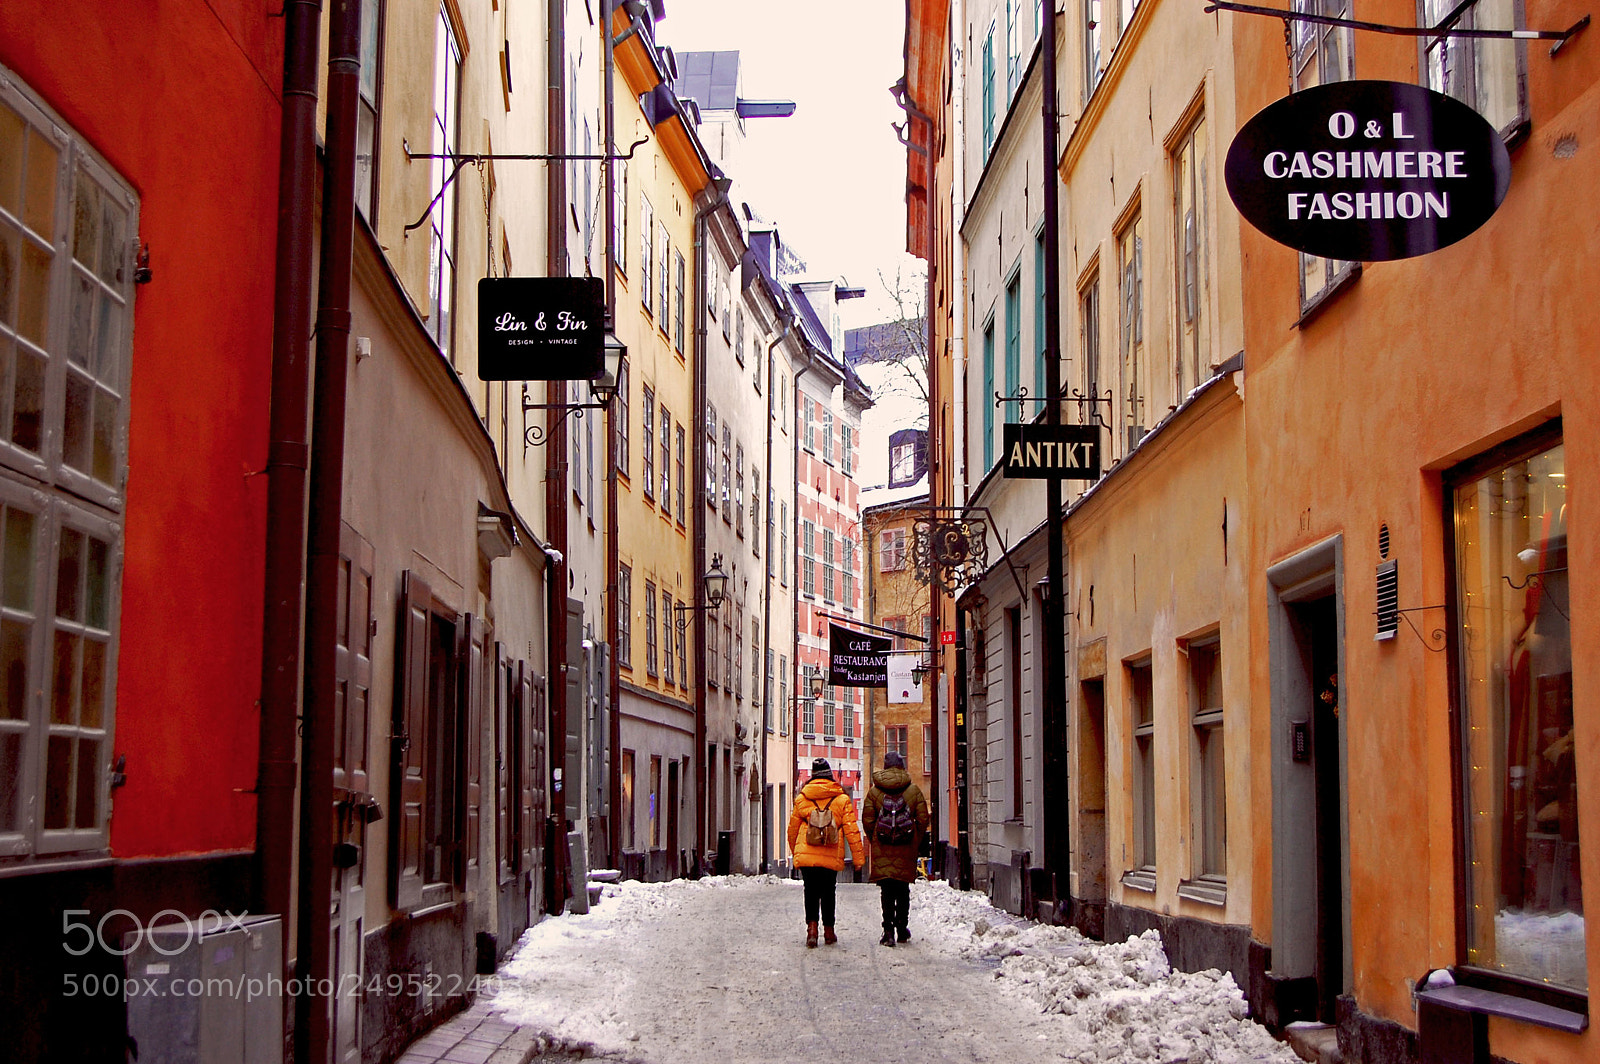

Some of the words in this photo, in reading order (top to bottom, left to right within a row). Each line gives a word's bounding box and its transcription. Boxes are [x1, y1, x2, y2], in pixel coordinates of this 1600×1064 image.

[1328, 112, 1355, 139] O
[1363, 120, 1381, 139] &
[1392, 112, 1414, 139] L
[1263, 151, 1467, 179] CASHMERE
[1287, 191, 1448, 220] FASHION
[494, 312, 528, 331] Lin
[535, 312, 547, 331] &
[556, 311, 588, 331] Fin
[1009, 441, 1094, 468] ANTIKT
[849, 640, 872, 651] CAFÉ
[833, 654, 887, 666] RESTAURANG
[847, 670, 886, 684] Kastanjen
